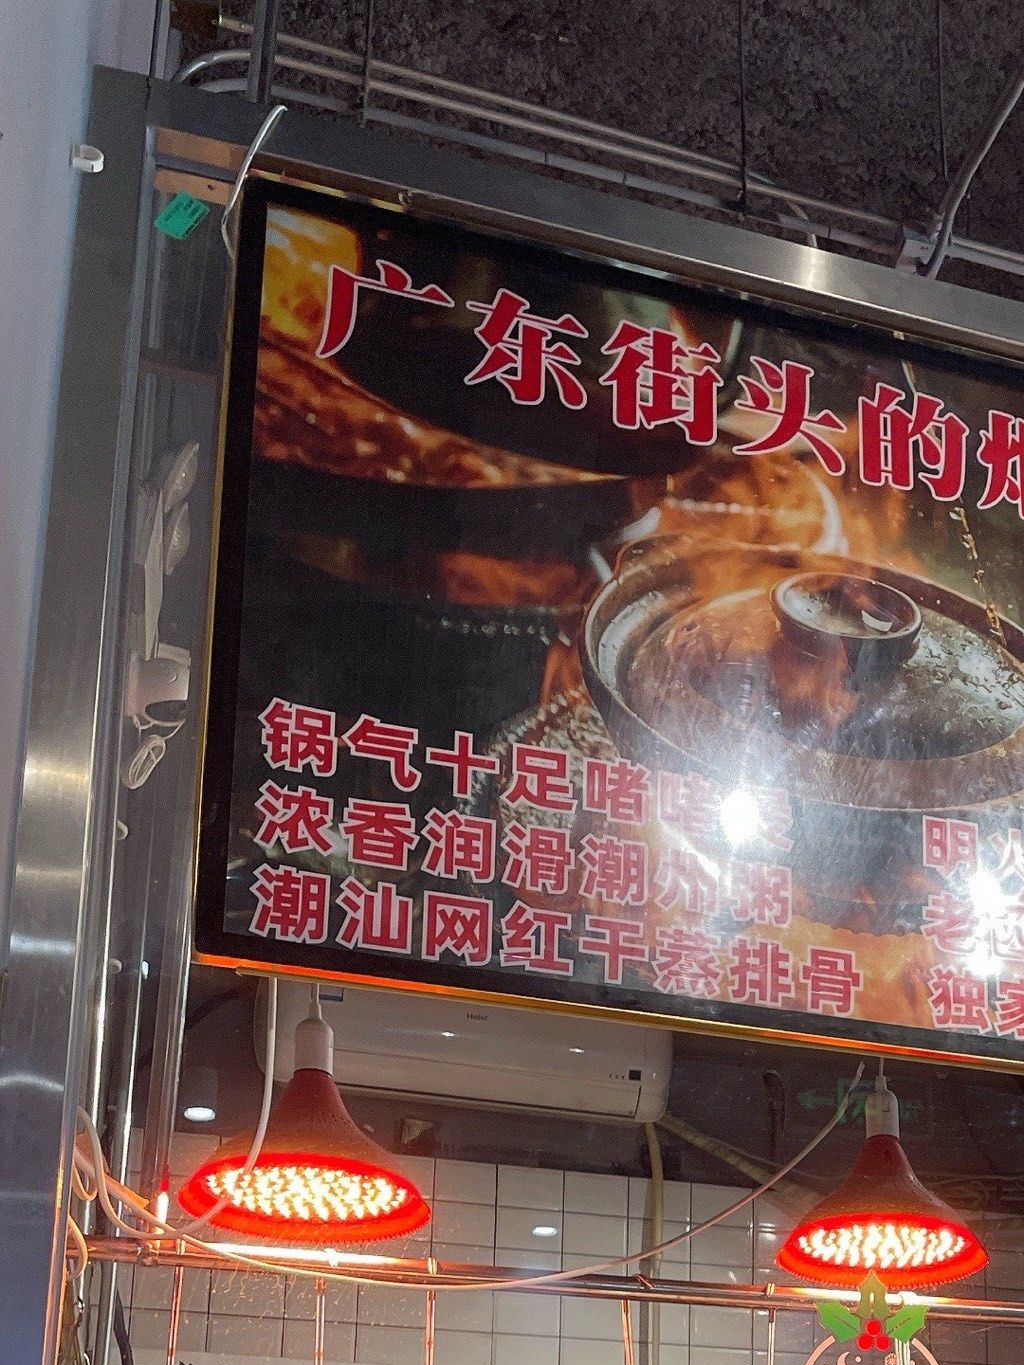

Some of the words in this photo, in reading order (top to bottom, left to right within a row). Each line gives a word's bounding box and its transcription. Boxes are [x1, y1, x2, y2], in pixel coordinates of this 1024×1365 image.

[254, 778, 794, 926] 浓香润滑潮州粥
[248, 864, 865, 1018] 潮汕网红干蒸排骨
